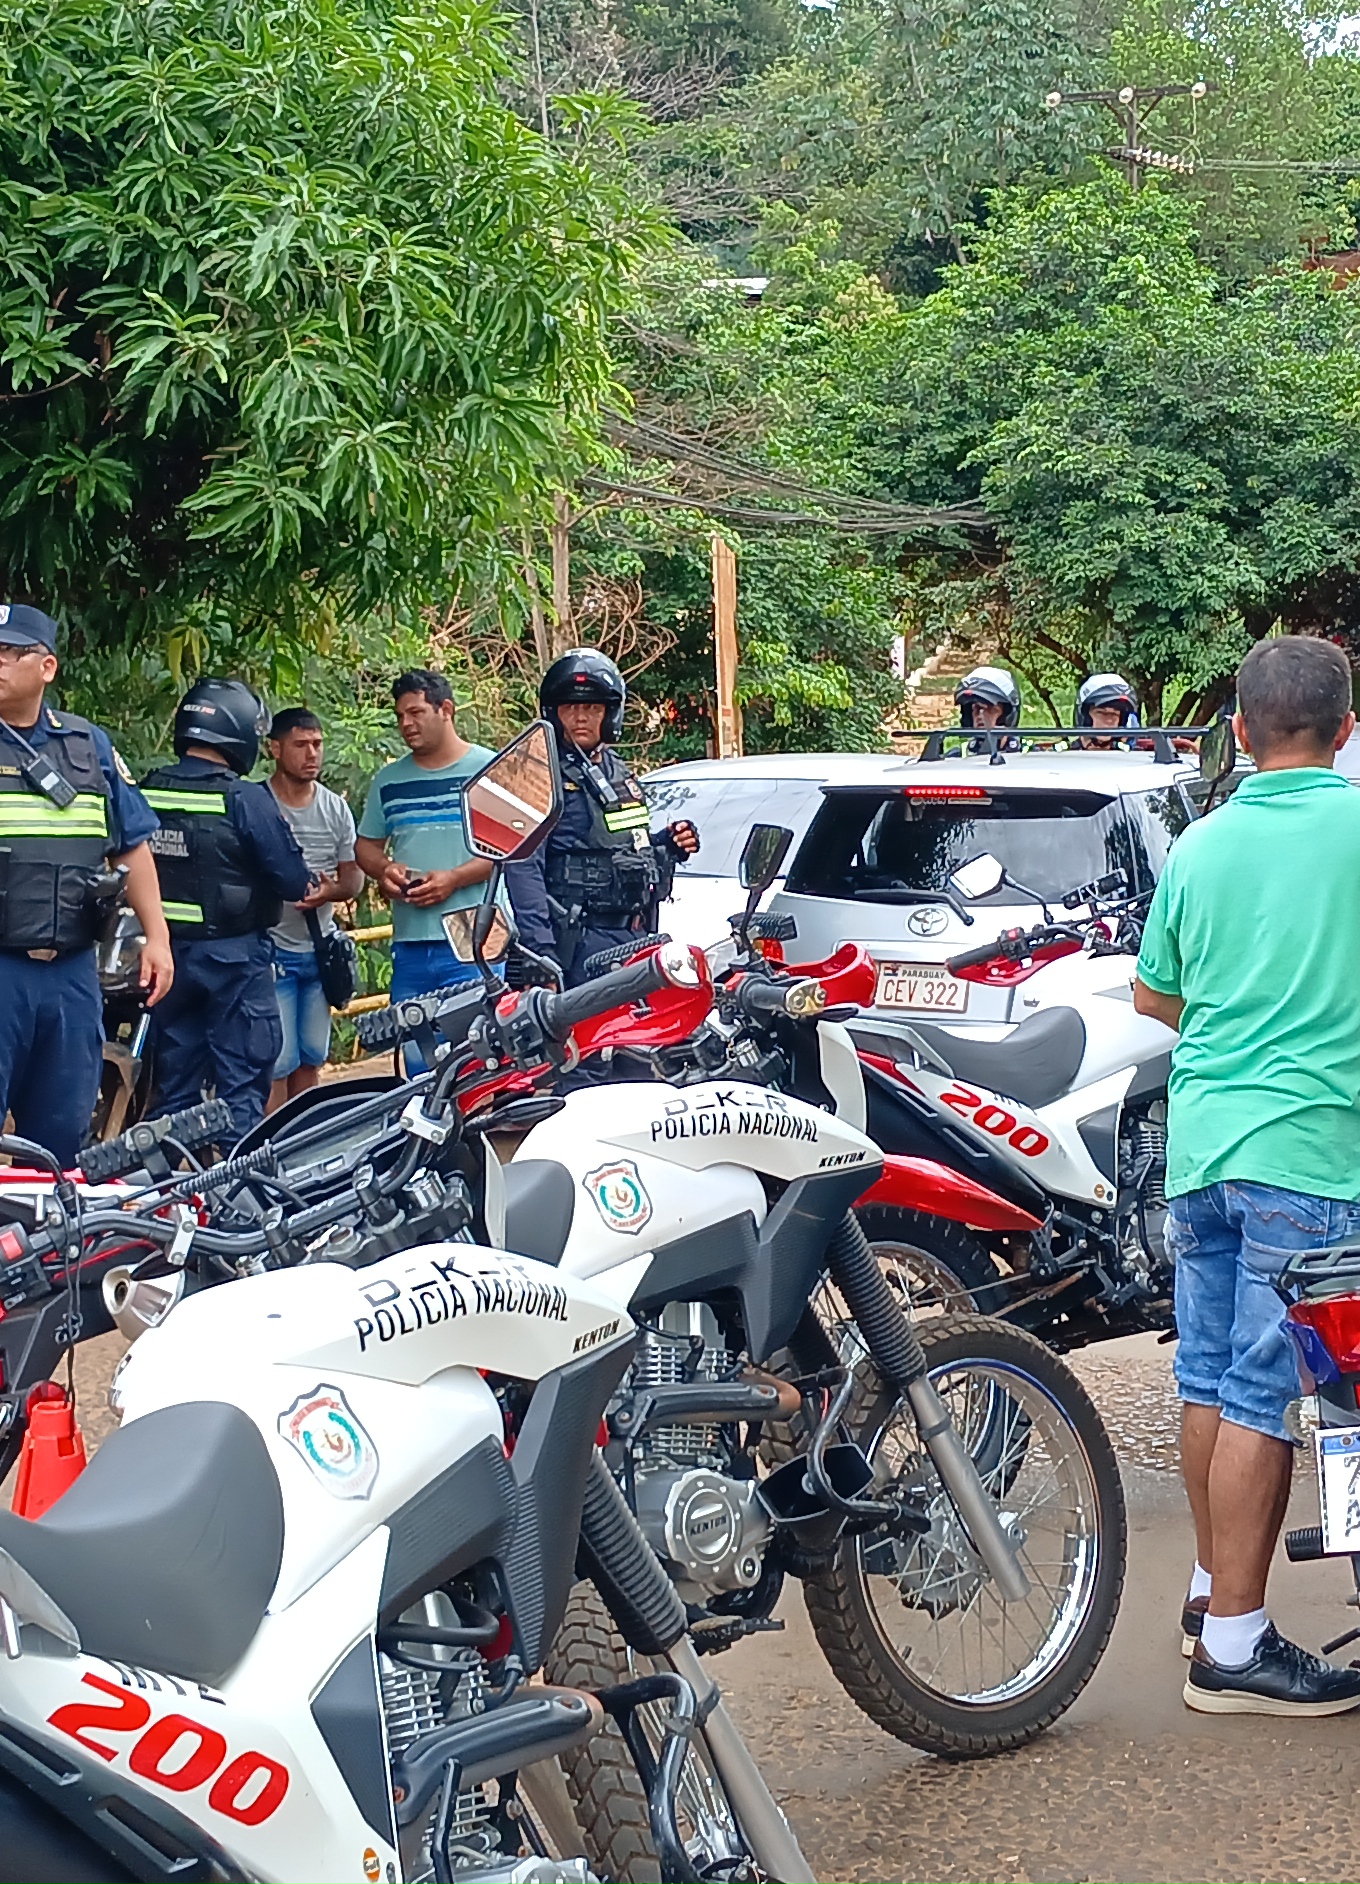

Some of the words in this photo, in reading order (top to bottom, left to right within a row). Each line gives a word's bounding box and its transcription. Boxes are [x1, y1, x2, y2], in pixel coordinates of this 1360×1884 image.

[149, 840, 190, 857] ACIONAL
[151, 829, 184, 843] OLICIA
[901, 969, 946, 979] PARAGUAY
[883, 979, 918, 1003] CEV
[923, 981, 959, 1006] 322
[651, 1112, 731, 1142] POLICIA
[737, 1111, 819, 1142] NACIONAL
[939, 1083, 1049, 1157] 200
[818, 1151, 867, 1168] KENTON
[353, 1284, 468, 1352] POLICIA
[472, 1278, 569, 1322] NACIONAL
[572, 1318, 620, 1353] KENTON
[46, 1671, 290, 1827] 200
